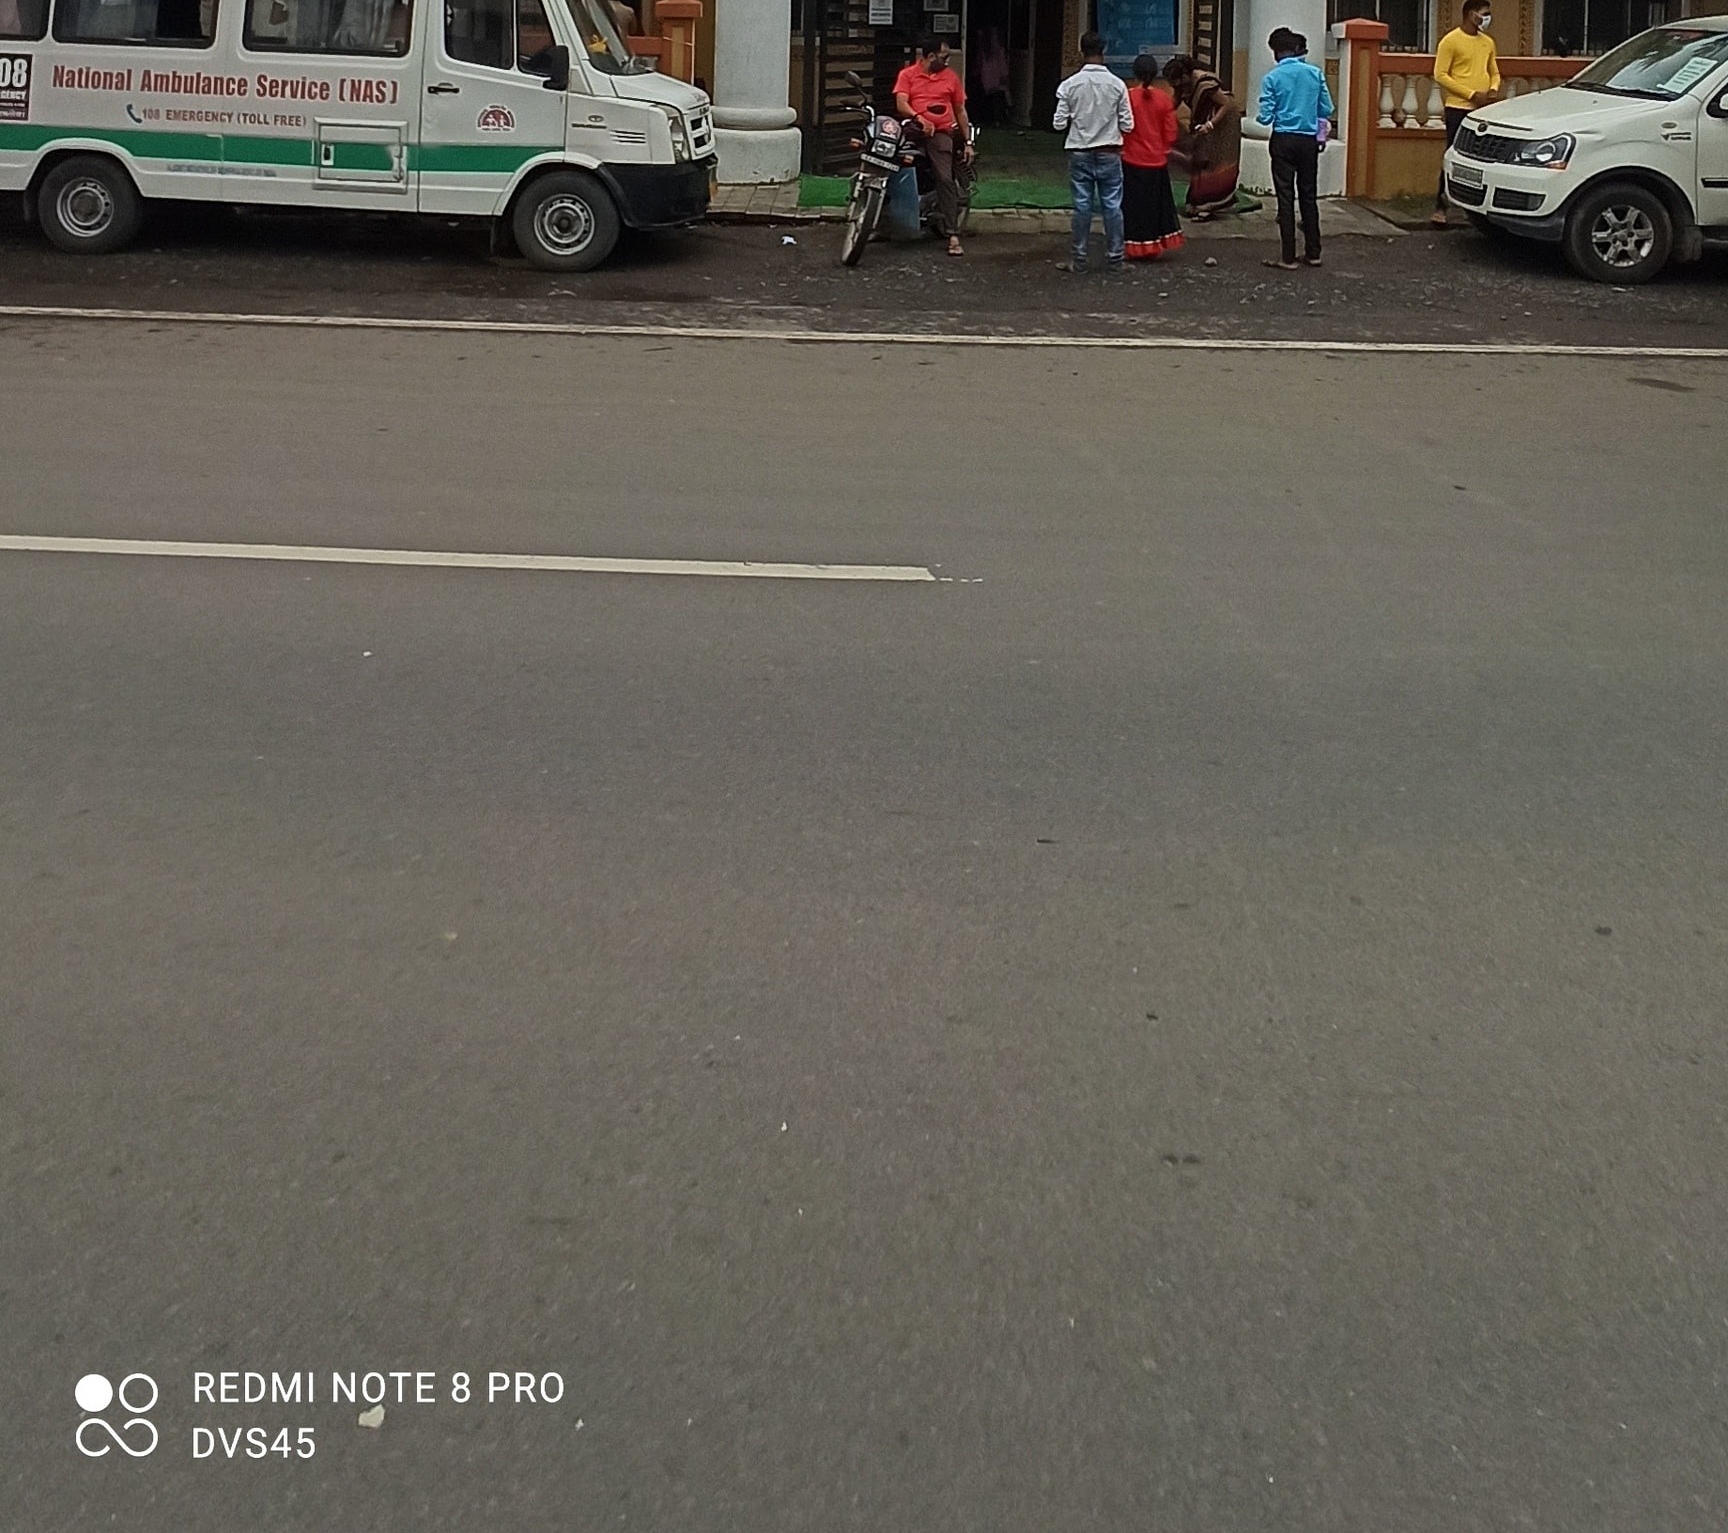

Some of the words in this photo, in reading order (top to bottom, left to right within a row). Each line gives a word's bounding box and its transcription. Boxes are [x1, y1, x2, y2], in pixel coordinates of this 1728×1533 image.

[0, 57, 28, 88] 08
[52, 65, 131, 91] National
[140, 70, 248, 96] Ambulance
[255, 74, 330, 100] Service
[142, 108, 161, 119] 108
[166, 109, 234, 123] EMERGENCY
[237, 112, 270, 125] (TOLL
[273, 114, 307, 127] FREE)
